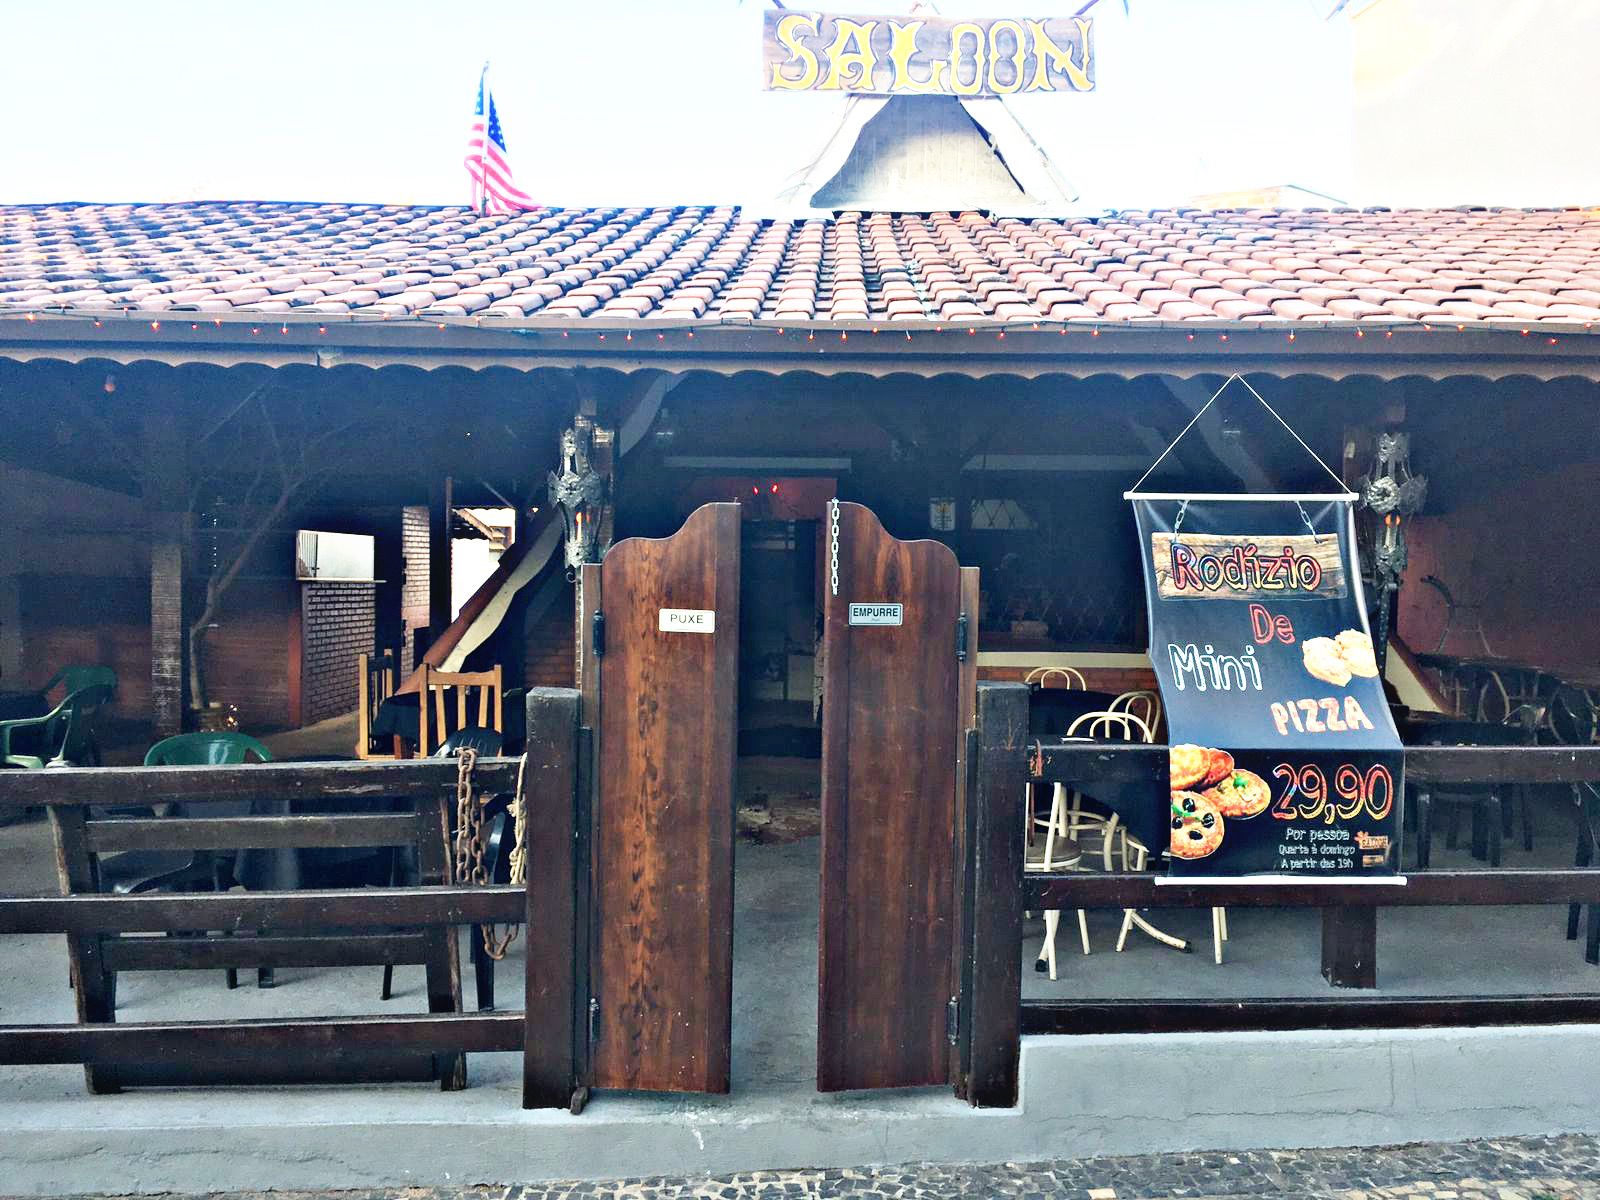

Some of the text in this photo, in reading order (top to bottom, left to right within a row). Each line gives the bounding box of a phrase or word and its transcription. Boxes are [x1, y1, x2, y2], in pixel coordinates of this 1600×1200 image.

[770, 12, 1096, 94] SALOON
[1171, 543, 1322, 591] Rodízio
[670, 613, 704, 624] PUXE
[853, 607, 898, 617] EMPURRE
[1250, 604, 1295, 644] De
[1168, 644, 1263, 691] Mini
[1271, 696, 1374, 735] PIZZA
[1272, 763, 1394, 825] 29,90
[1279, 844, 1309, 855] Quarta
[1320, 844, 1356, 856] domingo
[1285, 827, 1350, 842] Por pessoa
[1281, 858, 1354, 870] A partir das 19h
